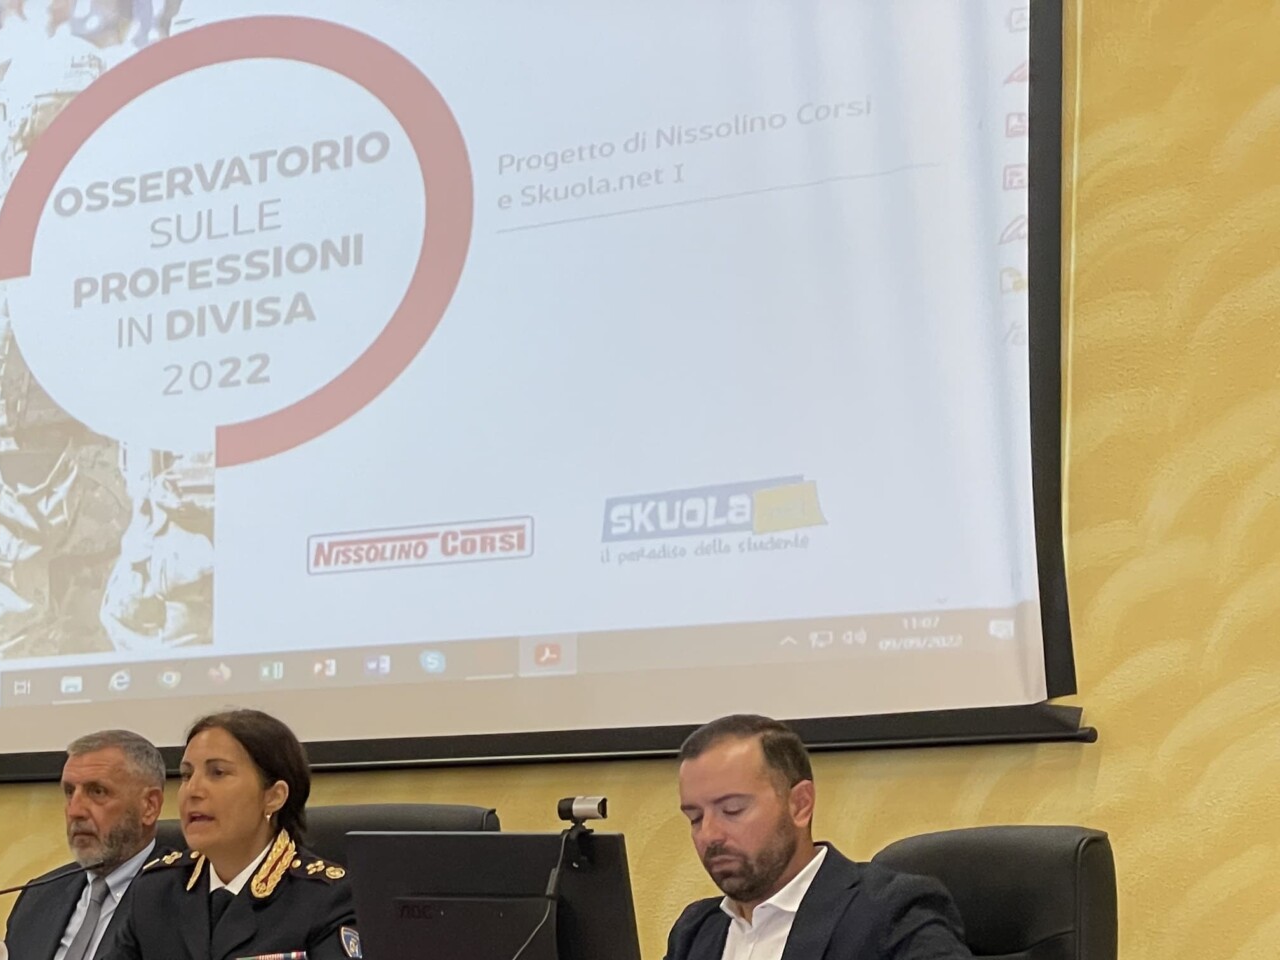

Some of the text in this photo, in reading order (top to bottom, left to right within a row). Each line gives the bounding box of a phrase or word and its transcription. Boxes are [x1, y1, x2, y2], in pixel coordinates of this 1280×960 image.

[498, 96, 872, 175] Progetto di Nissolino Corsi
[52, 131, 391, 218] OSSERVATORIO
[497, 193, 513, 210] e
[520, 165, 664, 207] Skuola.net
[150, 199, 282, 249] SULLE
[73, 233, 365, 309] PROFESSIONI
[117, 292, 316, 349] IN DIVISA
[162, 352, 271, 397] 2022
[313, 527, 525, 567] NISSOLINO CORSI
